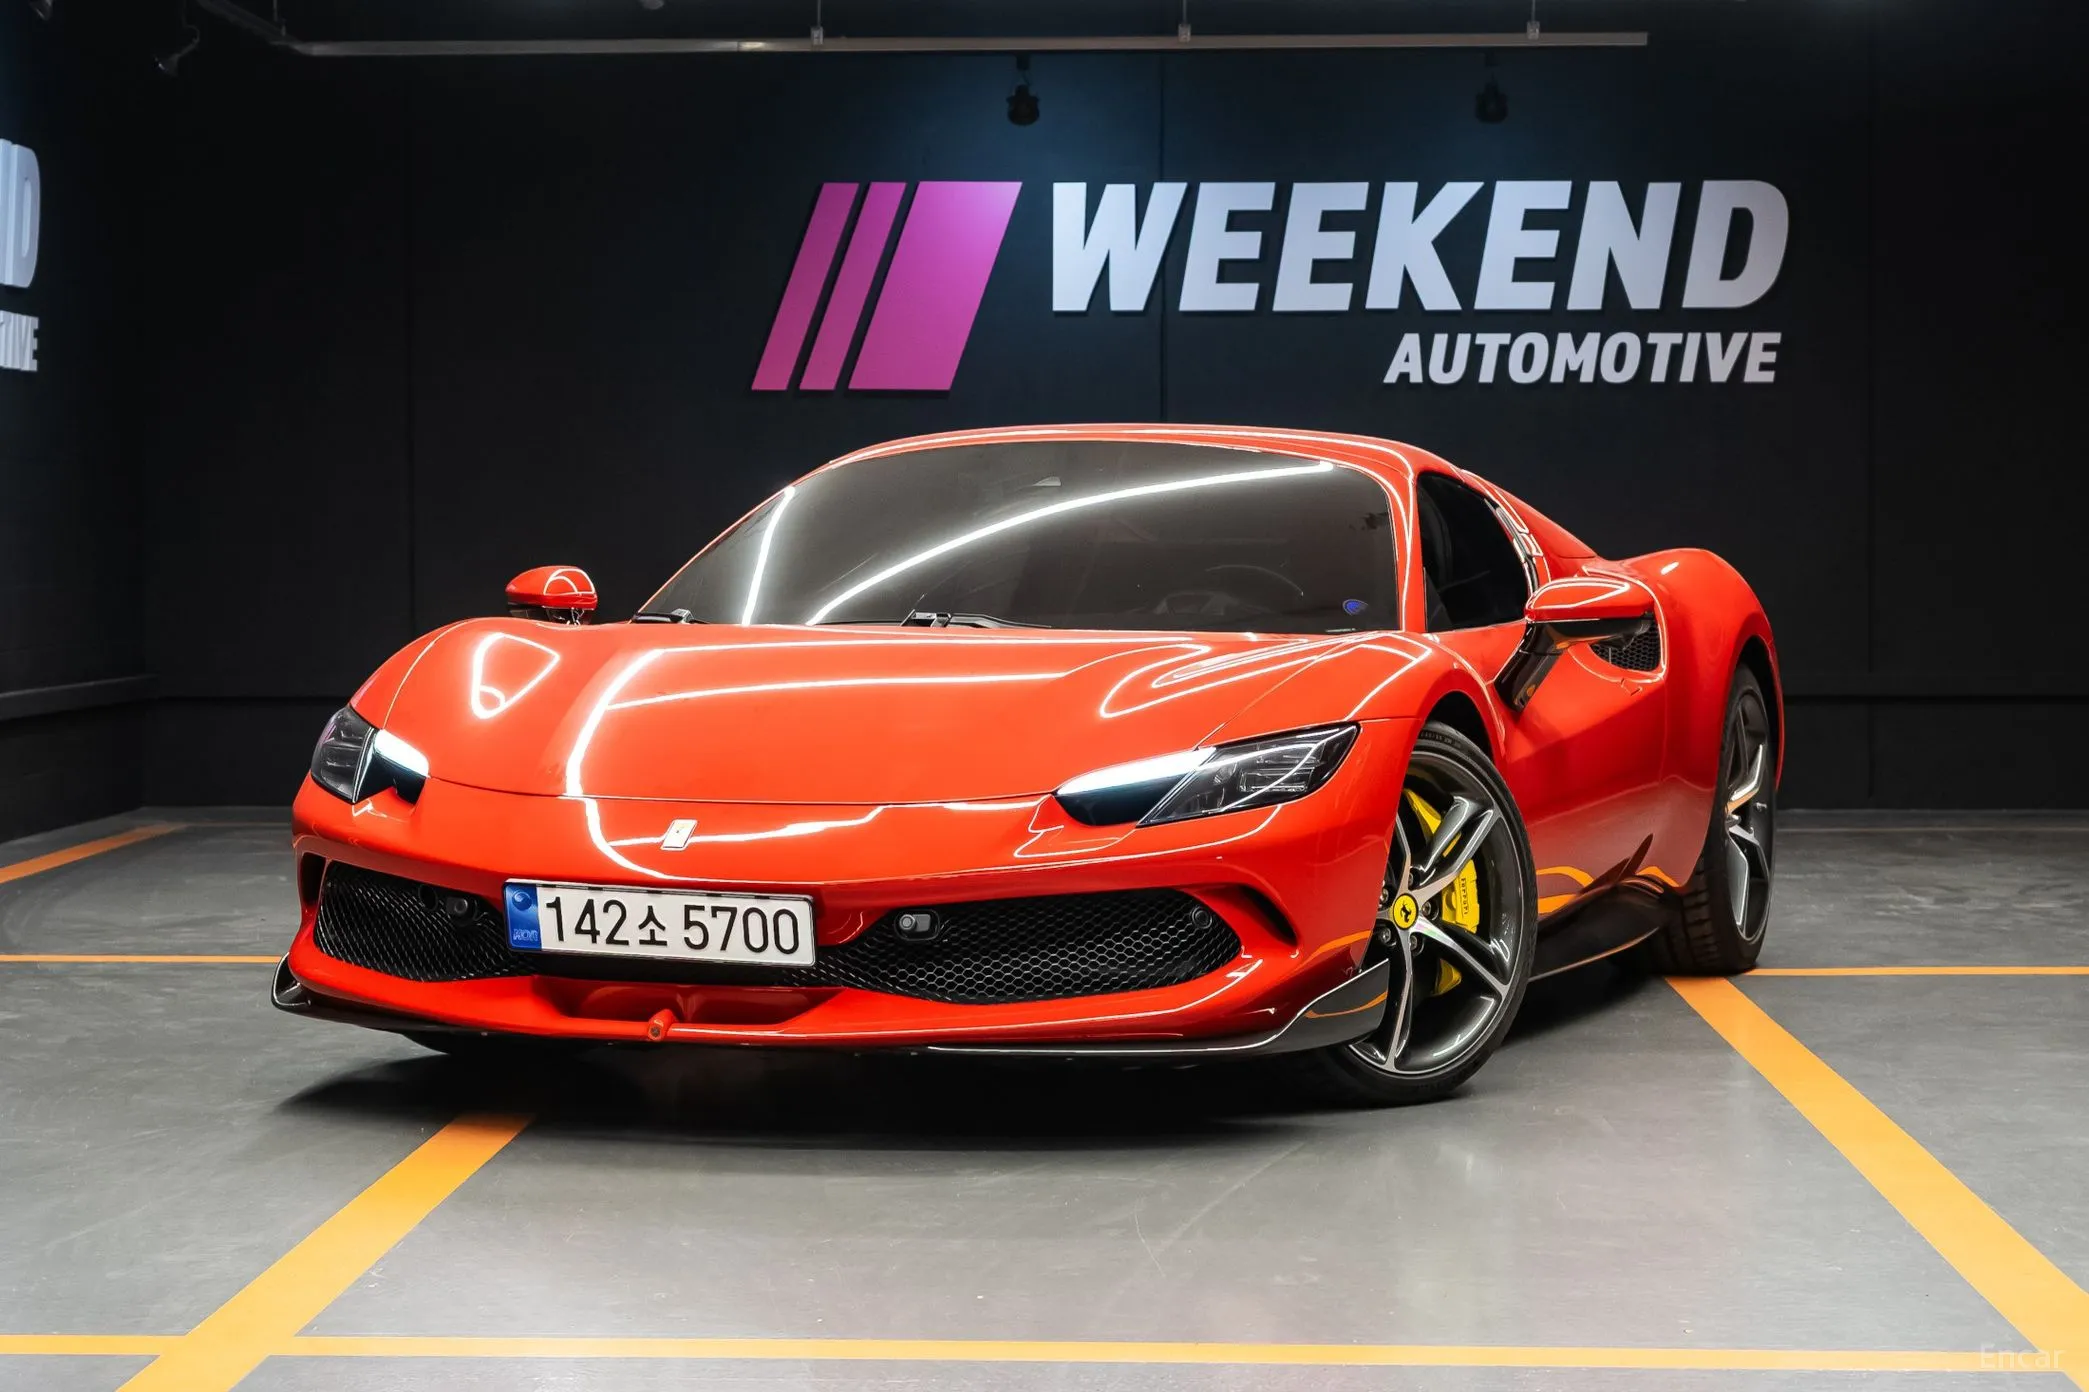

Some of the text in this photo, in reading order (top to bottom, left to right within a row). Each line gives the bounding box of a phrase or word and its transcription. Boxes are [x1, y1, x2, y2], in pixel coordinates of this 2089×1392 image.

[1052, 180, 1789, 312] WEEKEND
[1384, 332, 1782, 384] AUTOMOTIVE
[545, 896, 800, 954] 142소 5700
